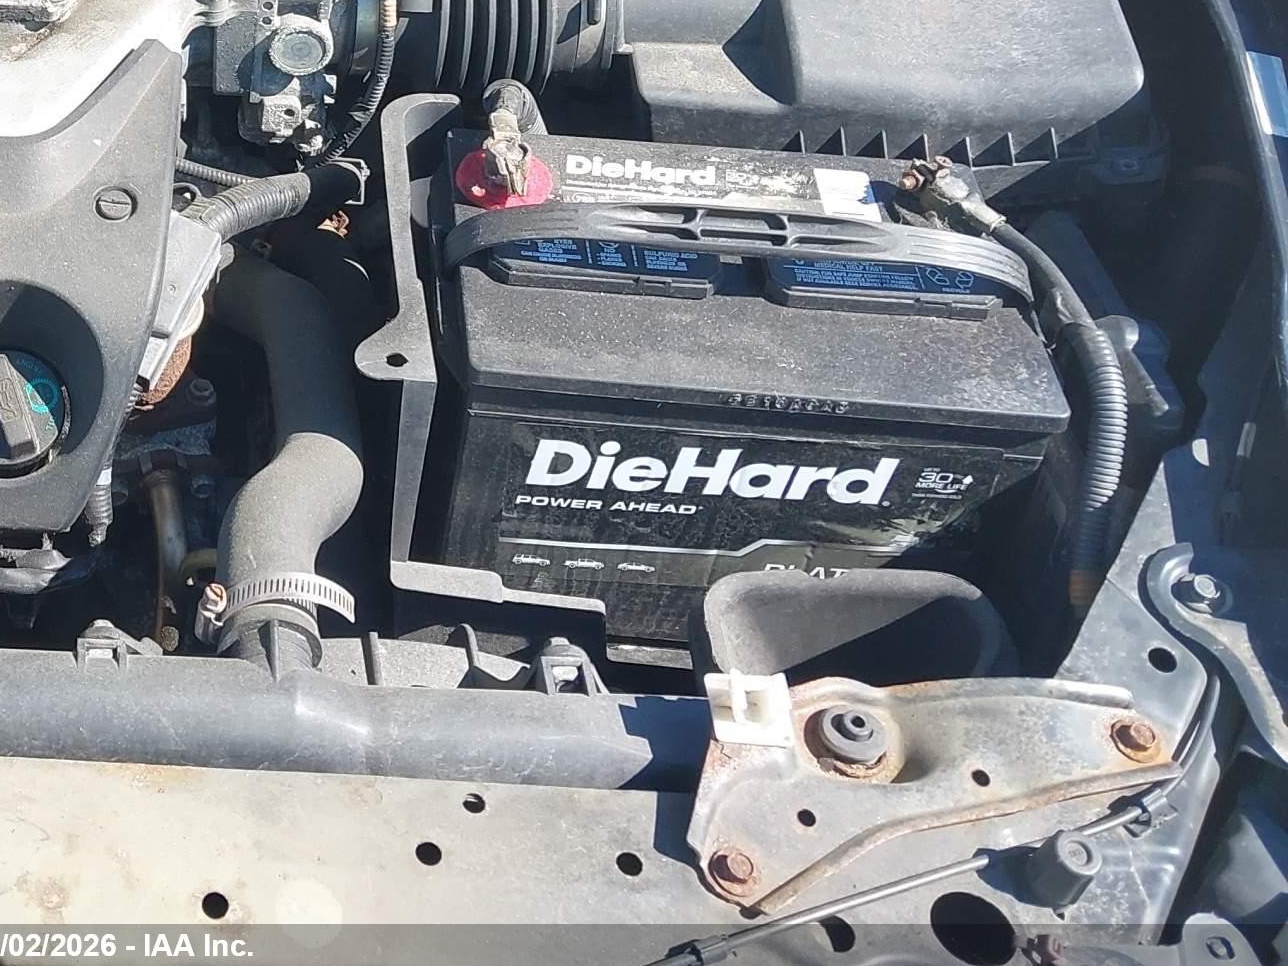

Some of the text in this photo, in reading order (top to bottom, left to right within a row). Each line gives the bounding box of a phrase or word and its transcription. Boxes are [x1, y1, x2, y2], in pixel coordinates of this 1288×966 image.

[565, 154, 716, 185] DieHard
[525, 439, 900, 507] DieHard
[514, 494, 699, 515] POWER AHEAD
